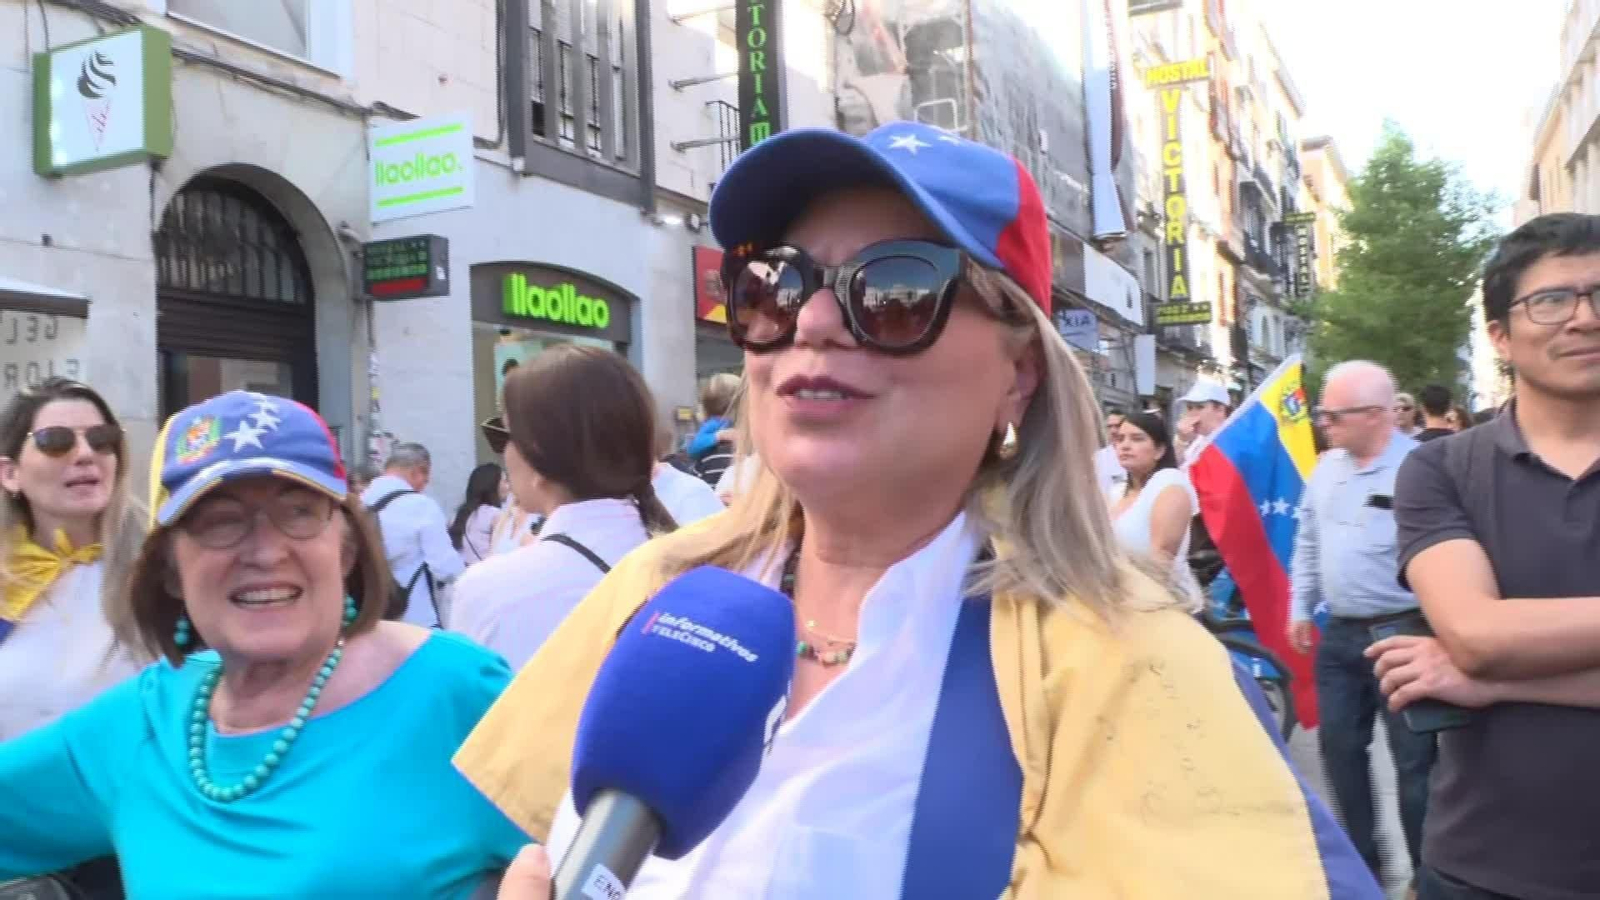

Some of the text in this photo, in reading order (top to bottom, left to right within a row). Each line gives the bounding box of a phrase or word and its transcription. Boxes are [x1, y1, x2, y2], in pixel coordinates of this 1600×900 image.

[746, 0, 768, 119] TORIA
[1160, 88, 1188, 297] VICTORIA
[507, 273, 609, 328] llaollao
